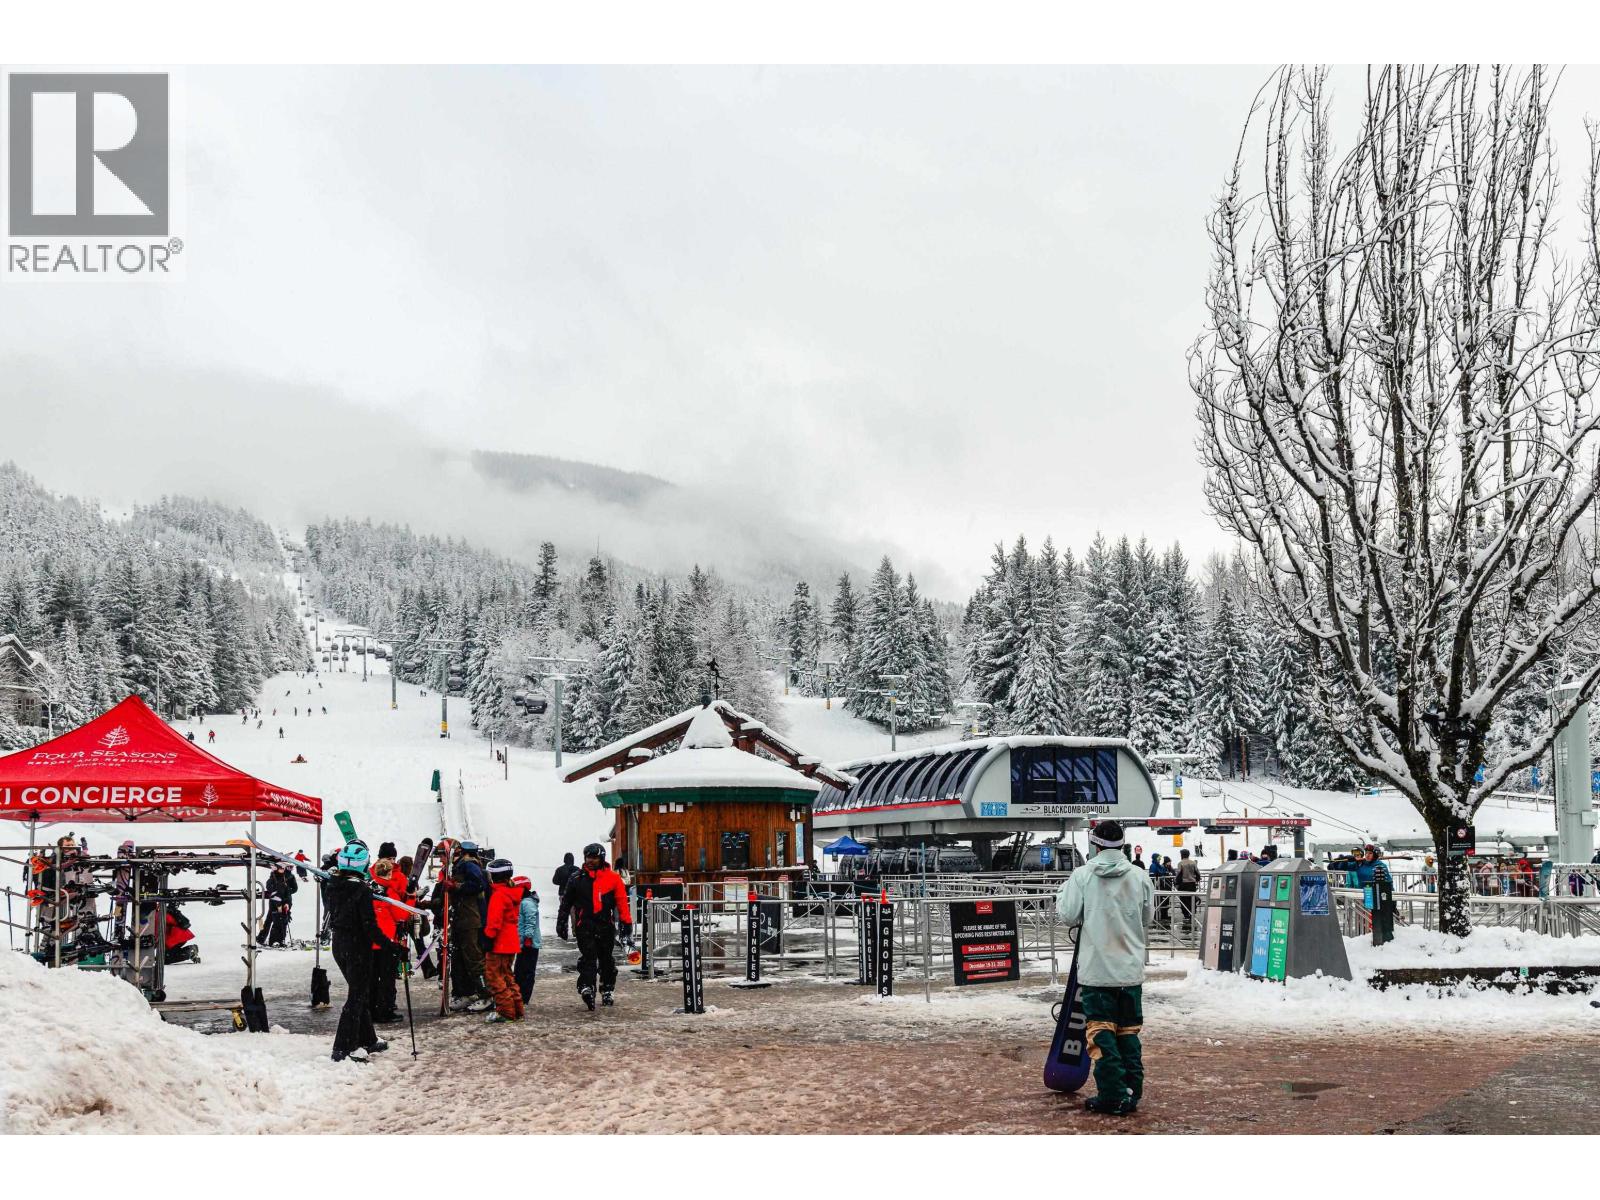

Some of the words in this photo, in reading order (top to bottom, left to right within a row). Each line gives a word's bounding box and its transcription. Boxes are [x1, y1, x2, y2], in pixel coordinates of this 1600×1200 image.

[32, 751, 85, 760] FOUR
[91, 750, 178, 759] SEASONS
[21, 786, 182, 805] CONCIERGE
[1043, 805, 1081, 814] BLACKCOMB
[694, 934, 702, 1006] GROUPS
